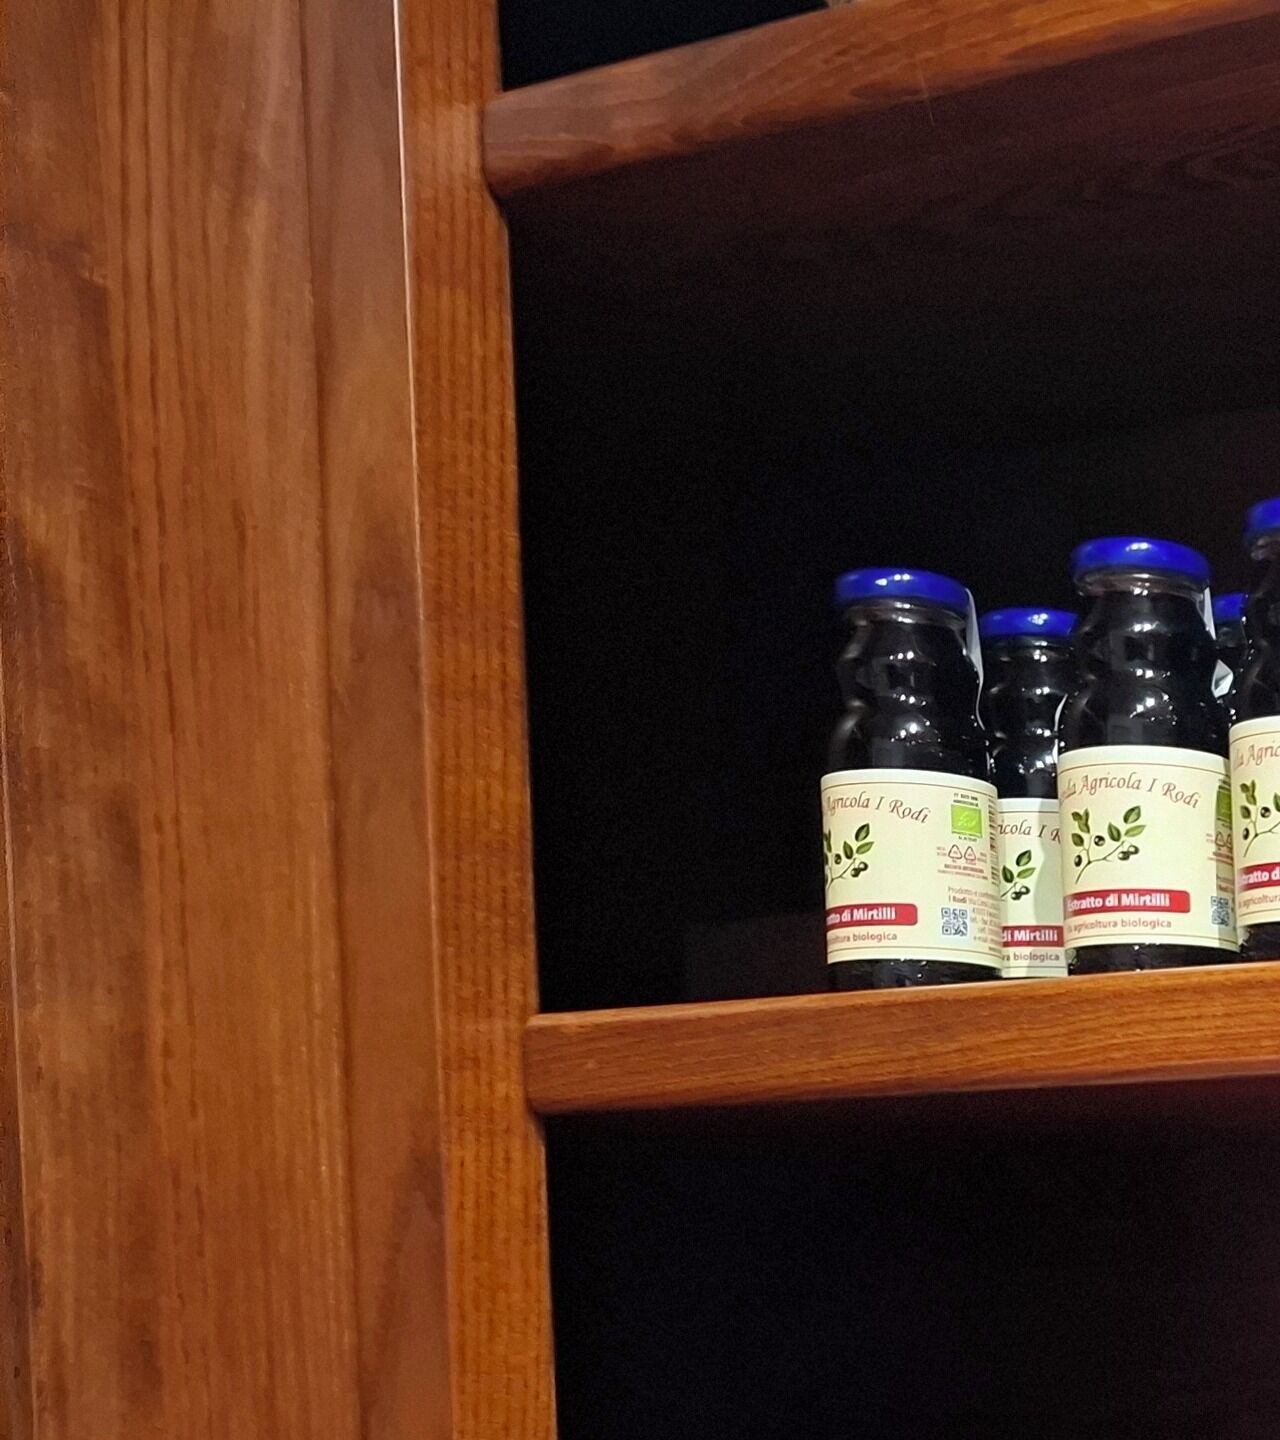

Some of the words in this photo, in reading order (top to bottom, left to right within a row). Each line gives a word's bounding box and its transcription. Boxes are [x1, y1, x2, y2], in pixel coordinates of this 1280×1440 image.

[1080, 772, 1142, 795] Agricola
[1162, 782, 1200, 809] Rodi
[889, 798, 932, 825] Rodi
[1106, 894, 1119, 907] di
[1121, 893, 1170, 907] Mirtilli
[853, 908, 896, 921] Mirtilli
[1121, 918, 1172, 930] biologica
[852, 931, 898, 944] biologica
[1014, 929, 1058, 942] Mirtilli
[1013, 951, 1060, 965] biologica
